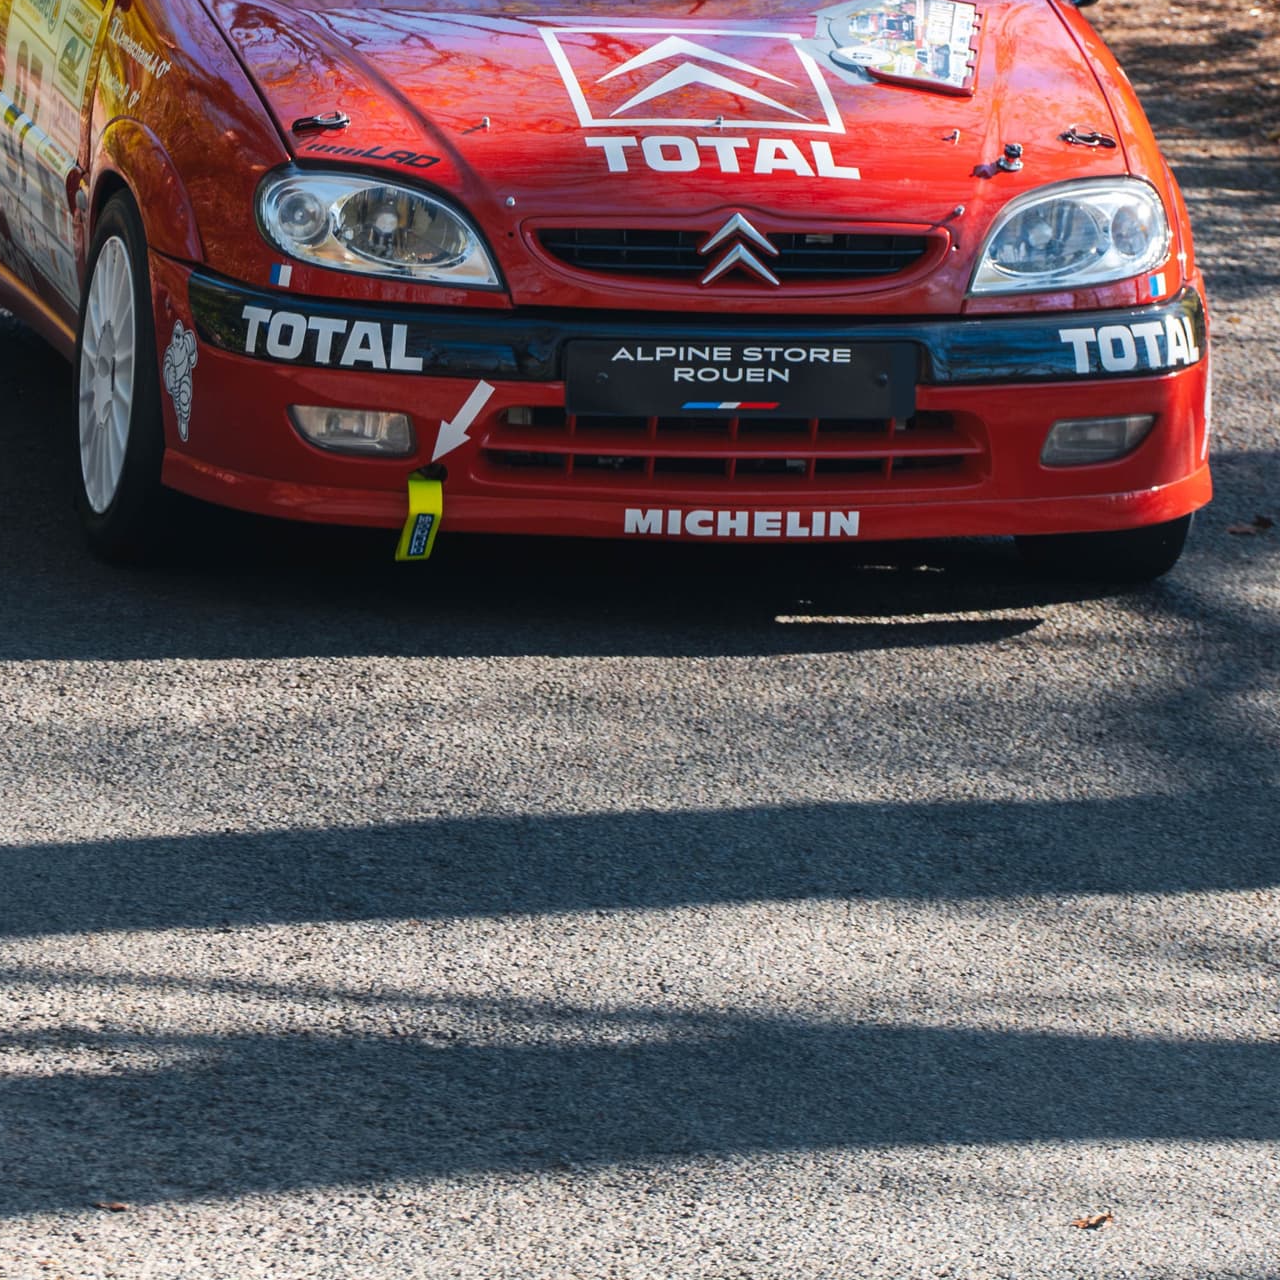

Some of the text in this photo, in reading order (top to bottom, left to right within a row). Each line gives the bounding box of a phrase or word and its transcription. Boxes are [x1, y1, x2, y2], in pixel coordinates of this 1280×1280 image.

[585, 135, 861, 180] TOTAL
[241, 304, 423, 371] TOTAL
[610, 347, 852, 364] ALPINE STORE
[1060, 317, 1201, 375] TOTAL
[673, 367, 791, 383] ROUEN
[623, 508, 860, 537] MICHELIN
